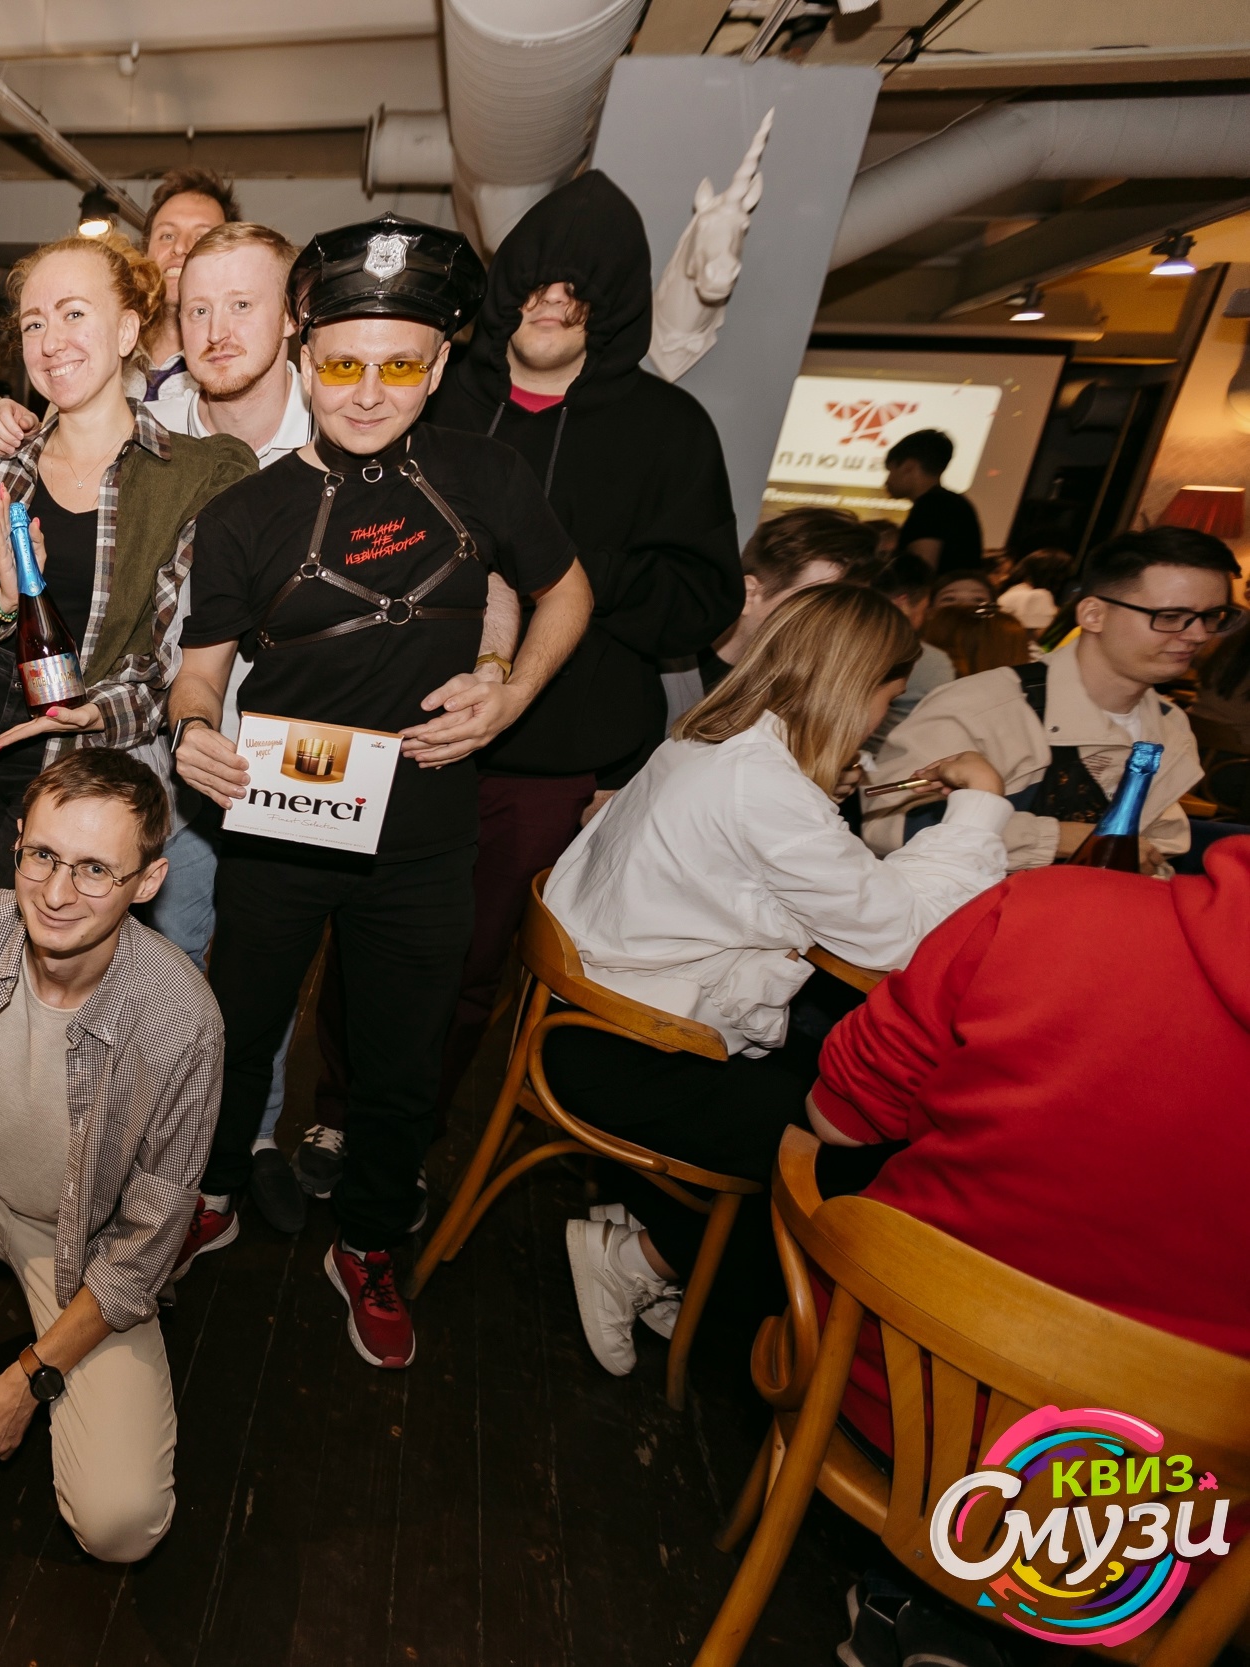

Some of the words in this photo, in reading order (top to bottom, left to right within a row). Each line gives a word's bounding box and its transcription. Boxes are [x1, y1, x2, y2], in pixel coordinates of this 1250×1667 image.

[350, 517, 405, 541] ПАЦАНЫ
[345, 530, 427, 565] ИЗВИНЯЮТСЯ
[371, 534, 393, 548] НЕ
[255, 749, 271, 760] мусс
[248, 788, 366, 822] merci
[266, 813, 301, 824] Finest
[301, 818, 340, 831] Selection
